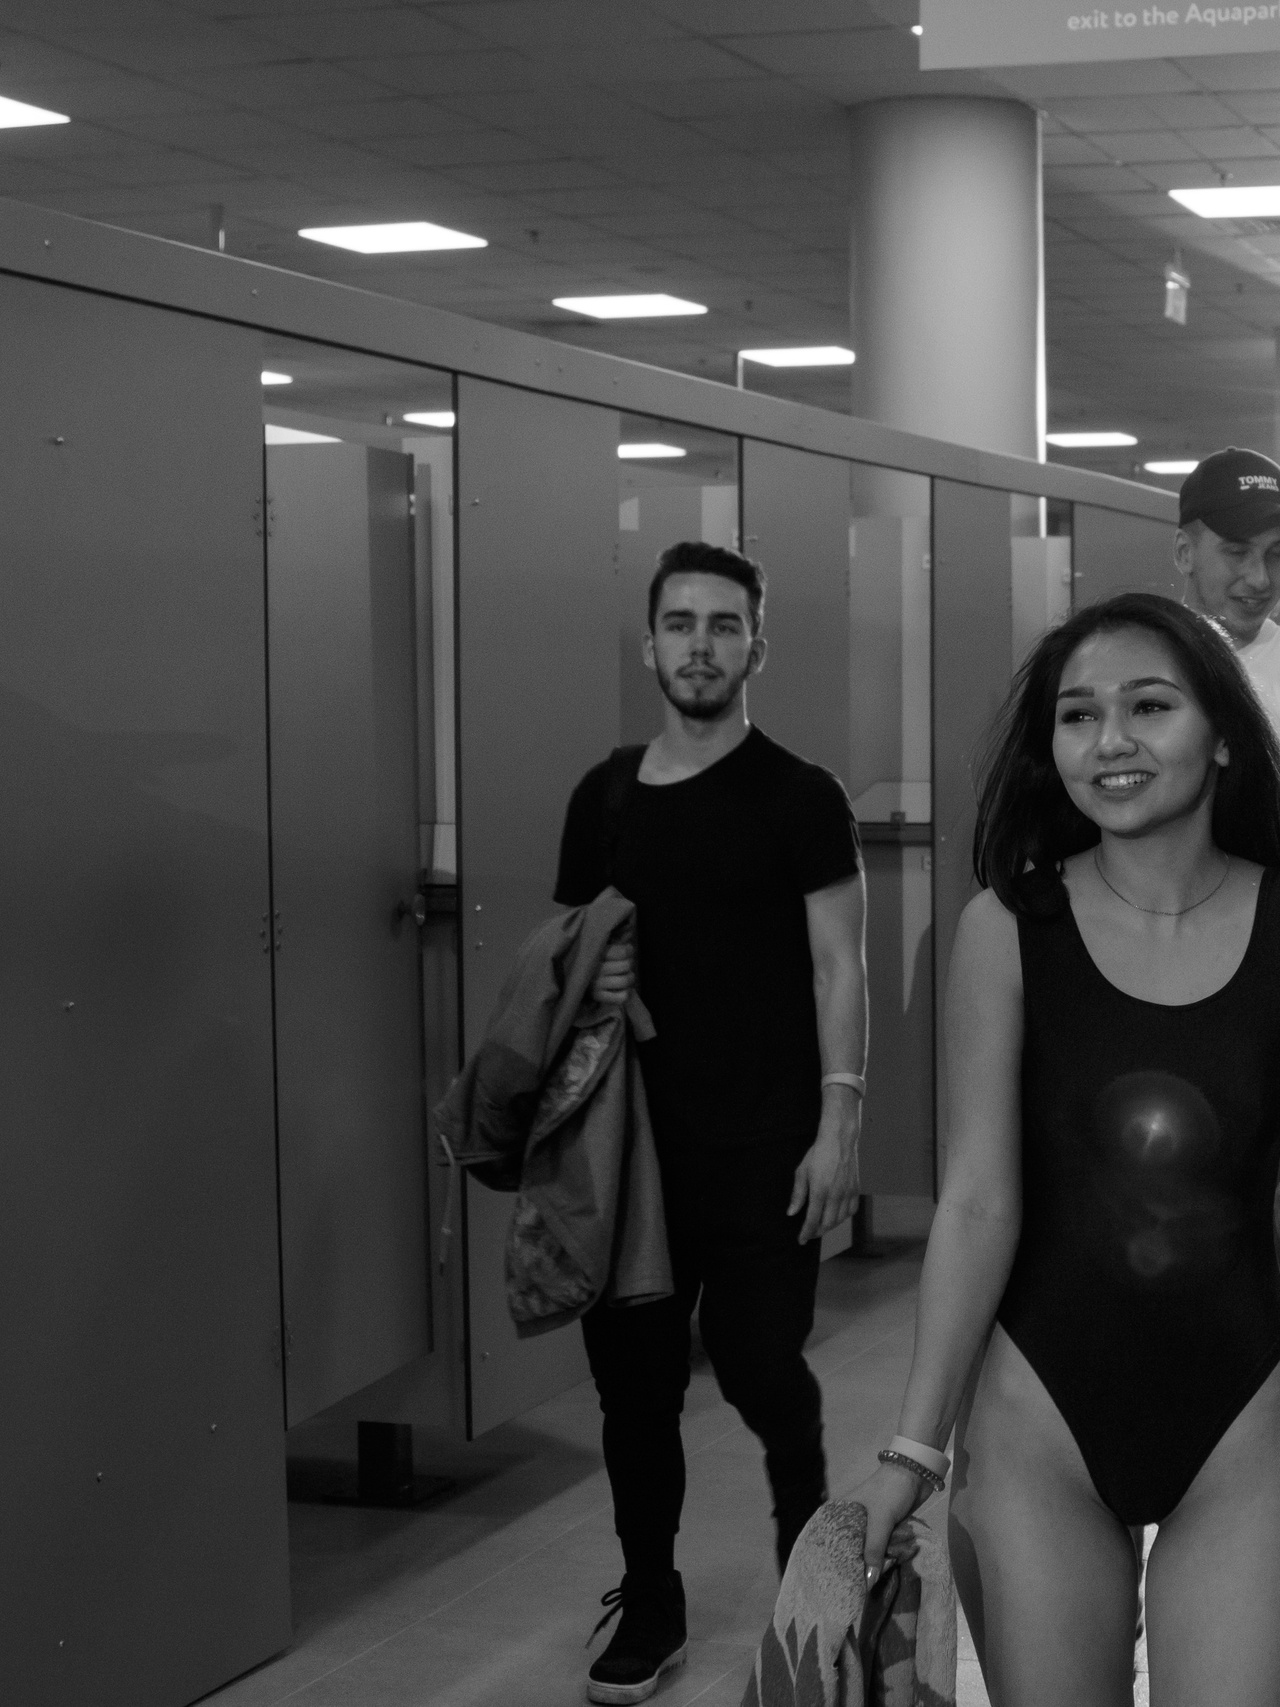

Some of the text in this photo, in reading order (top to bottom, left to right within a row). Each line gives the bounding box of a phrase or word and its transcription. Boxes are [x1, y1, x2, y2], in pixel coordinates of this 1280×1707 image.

[1067, 9, 1109, 30] exit
[1114, 11, 1137, 28] to
[1142, 6, 1180, 26] the
[1238, 475, 1278, 486] TOMMY
[1258, 482, 1280, 492] JEANS
